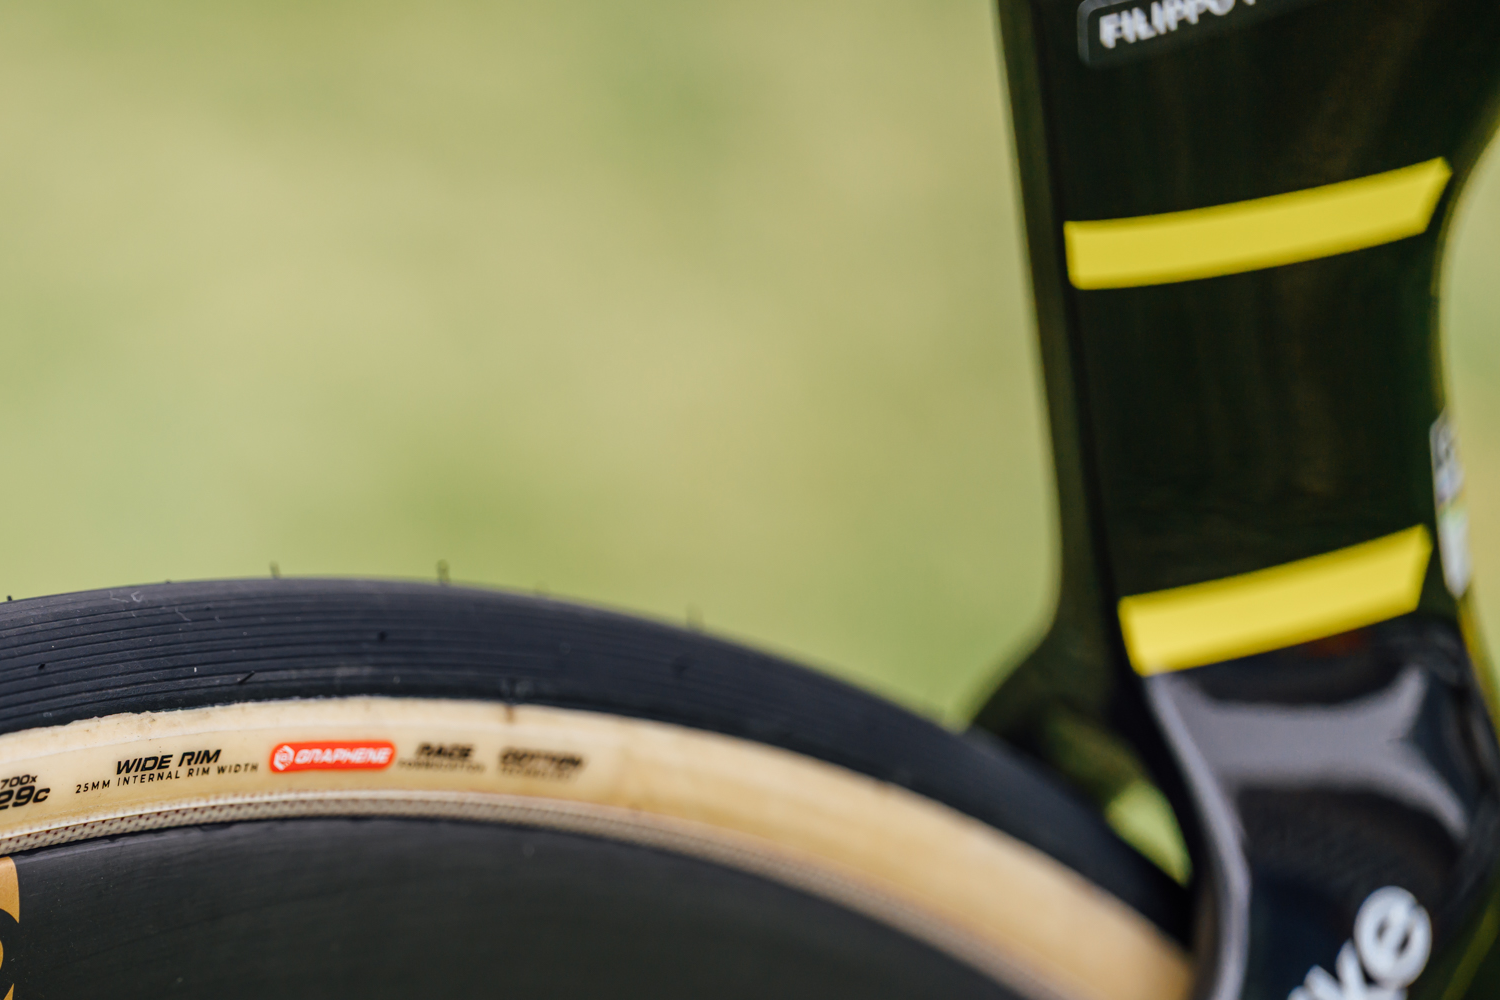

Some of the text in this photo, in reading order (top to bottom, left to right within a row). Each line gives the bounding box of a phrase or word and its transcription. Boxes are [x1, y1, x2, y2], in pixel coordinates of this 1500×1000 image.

[116, 749, 222, 775] WIDE RIM
[294, 747, 393, 765] GRAPHENE
[75, 762, 260, 794] 25MM INTERNAL RIM WIDTH
